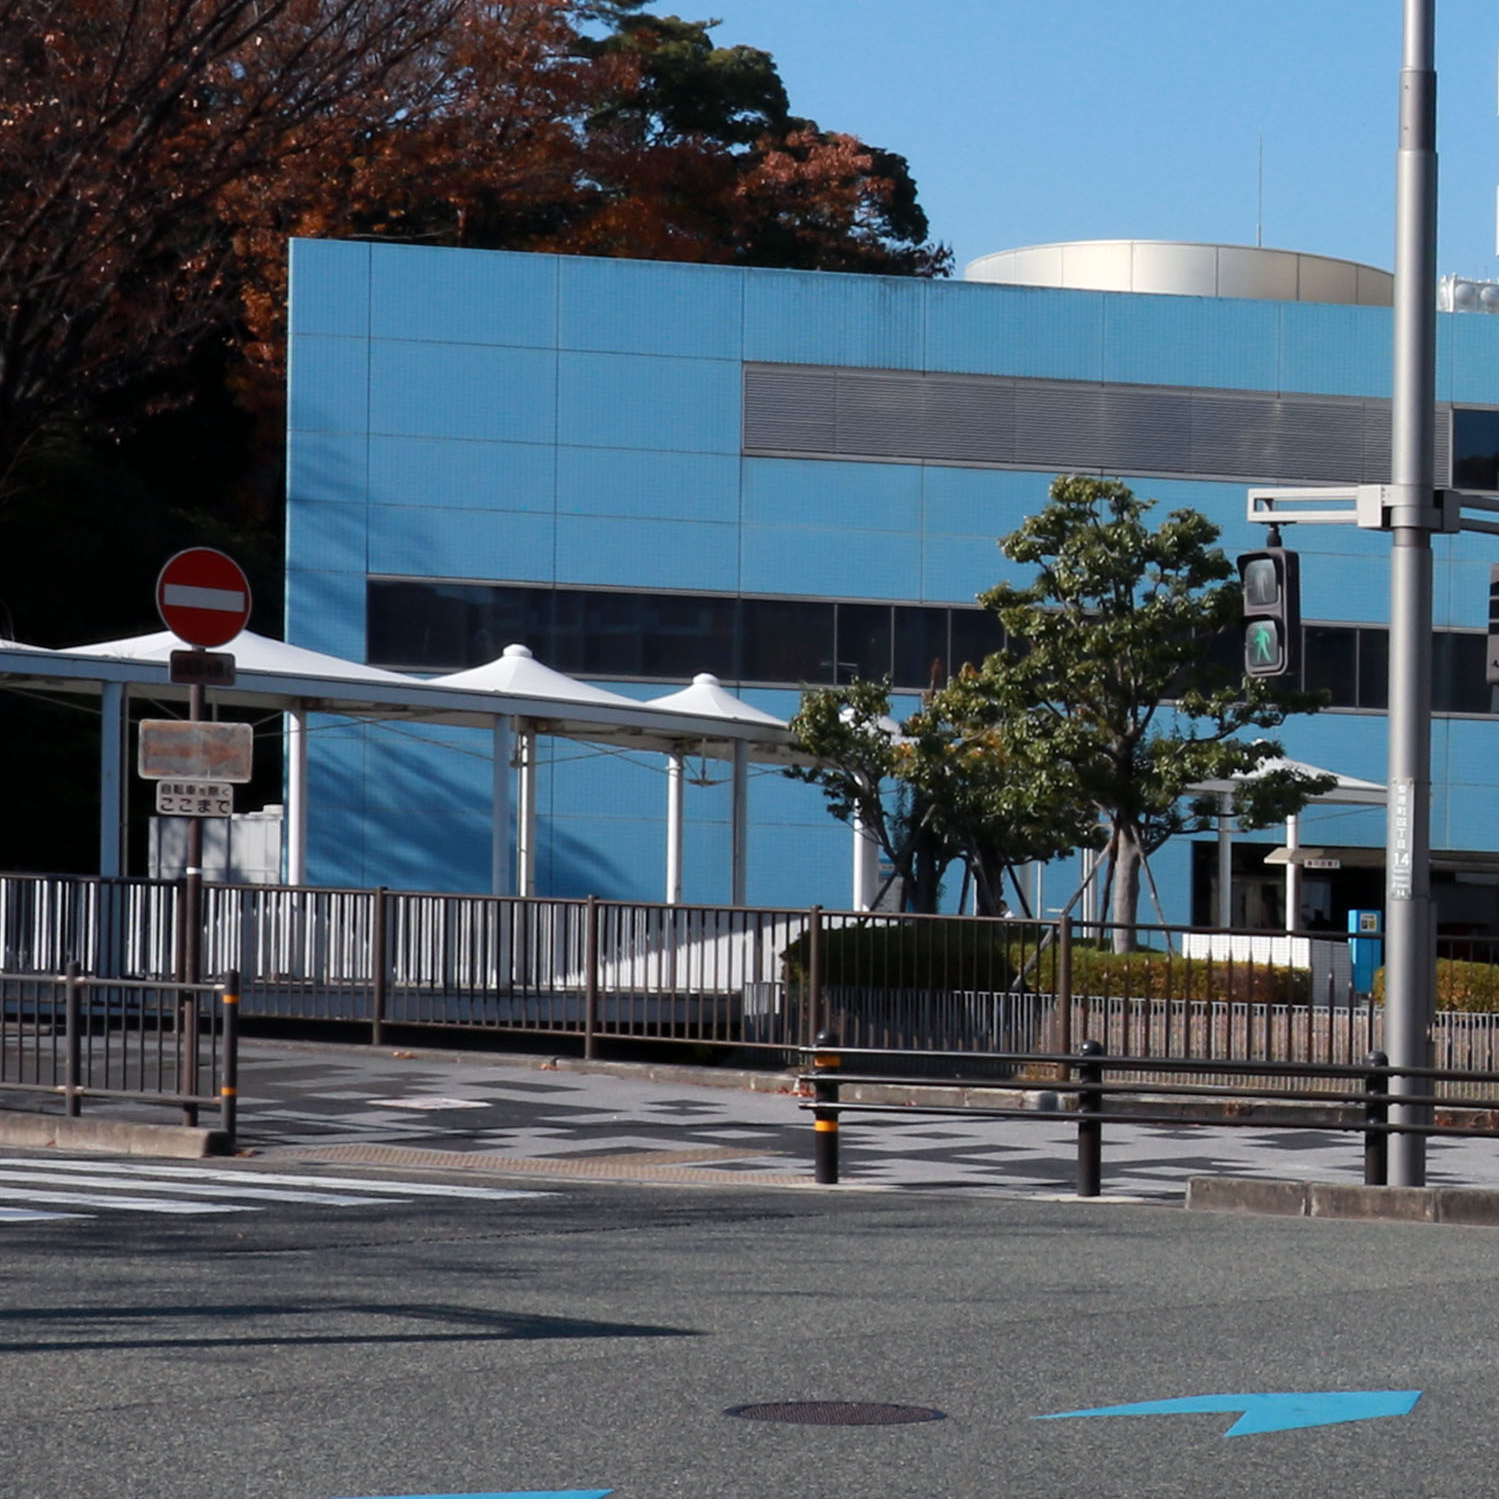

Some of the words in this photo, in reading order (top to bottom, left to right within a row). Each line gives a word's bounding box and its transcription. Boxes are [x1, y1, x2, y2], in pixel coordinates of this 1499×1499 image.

[160, 797, 230, 814] ここまで
[1393, 852, 1409, 866] 14
